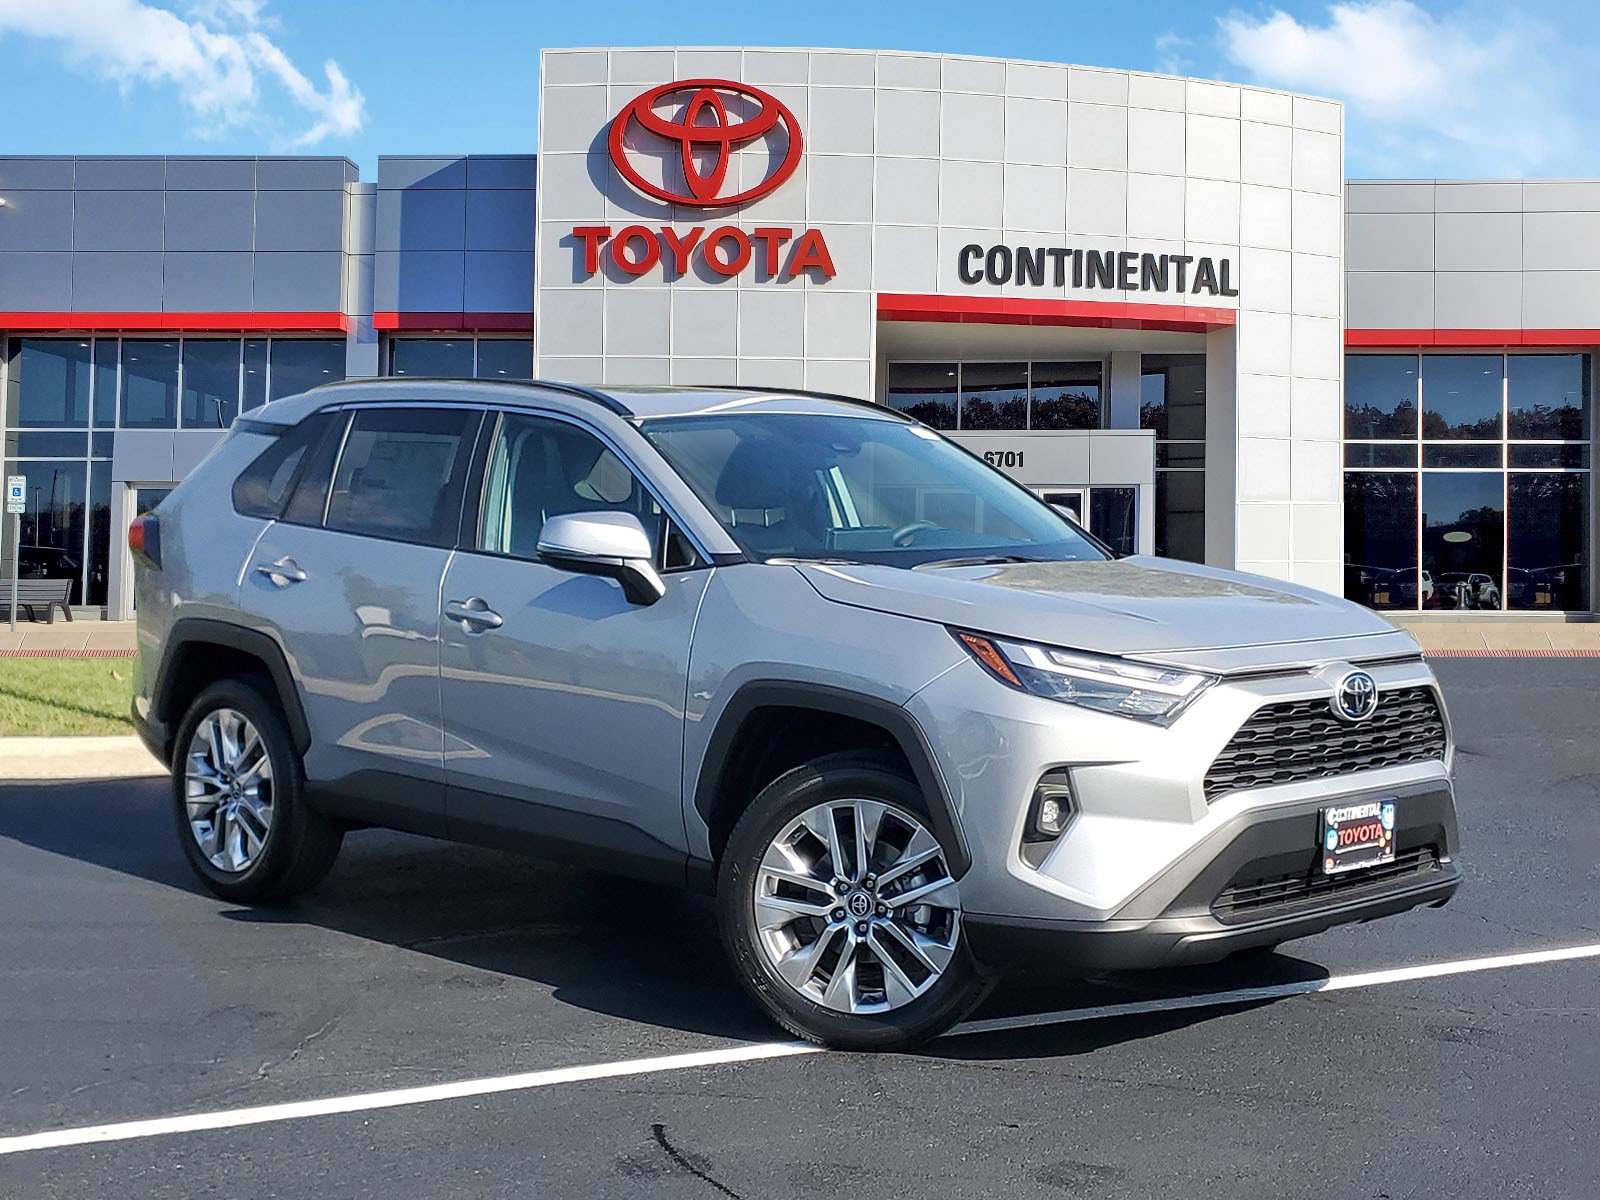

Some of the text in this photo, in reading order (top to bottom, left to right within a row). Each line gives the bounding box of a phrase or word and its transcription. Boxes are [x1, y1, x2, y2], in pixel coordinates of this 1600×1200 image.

[573, 225, 836, 277] TOYOTA
[958, 244, 1239, 297] CONTINENTAL
[984, 451, 1024, 467] 6701
[1338, 823, 1383, 846] TOYOTA
